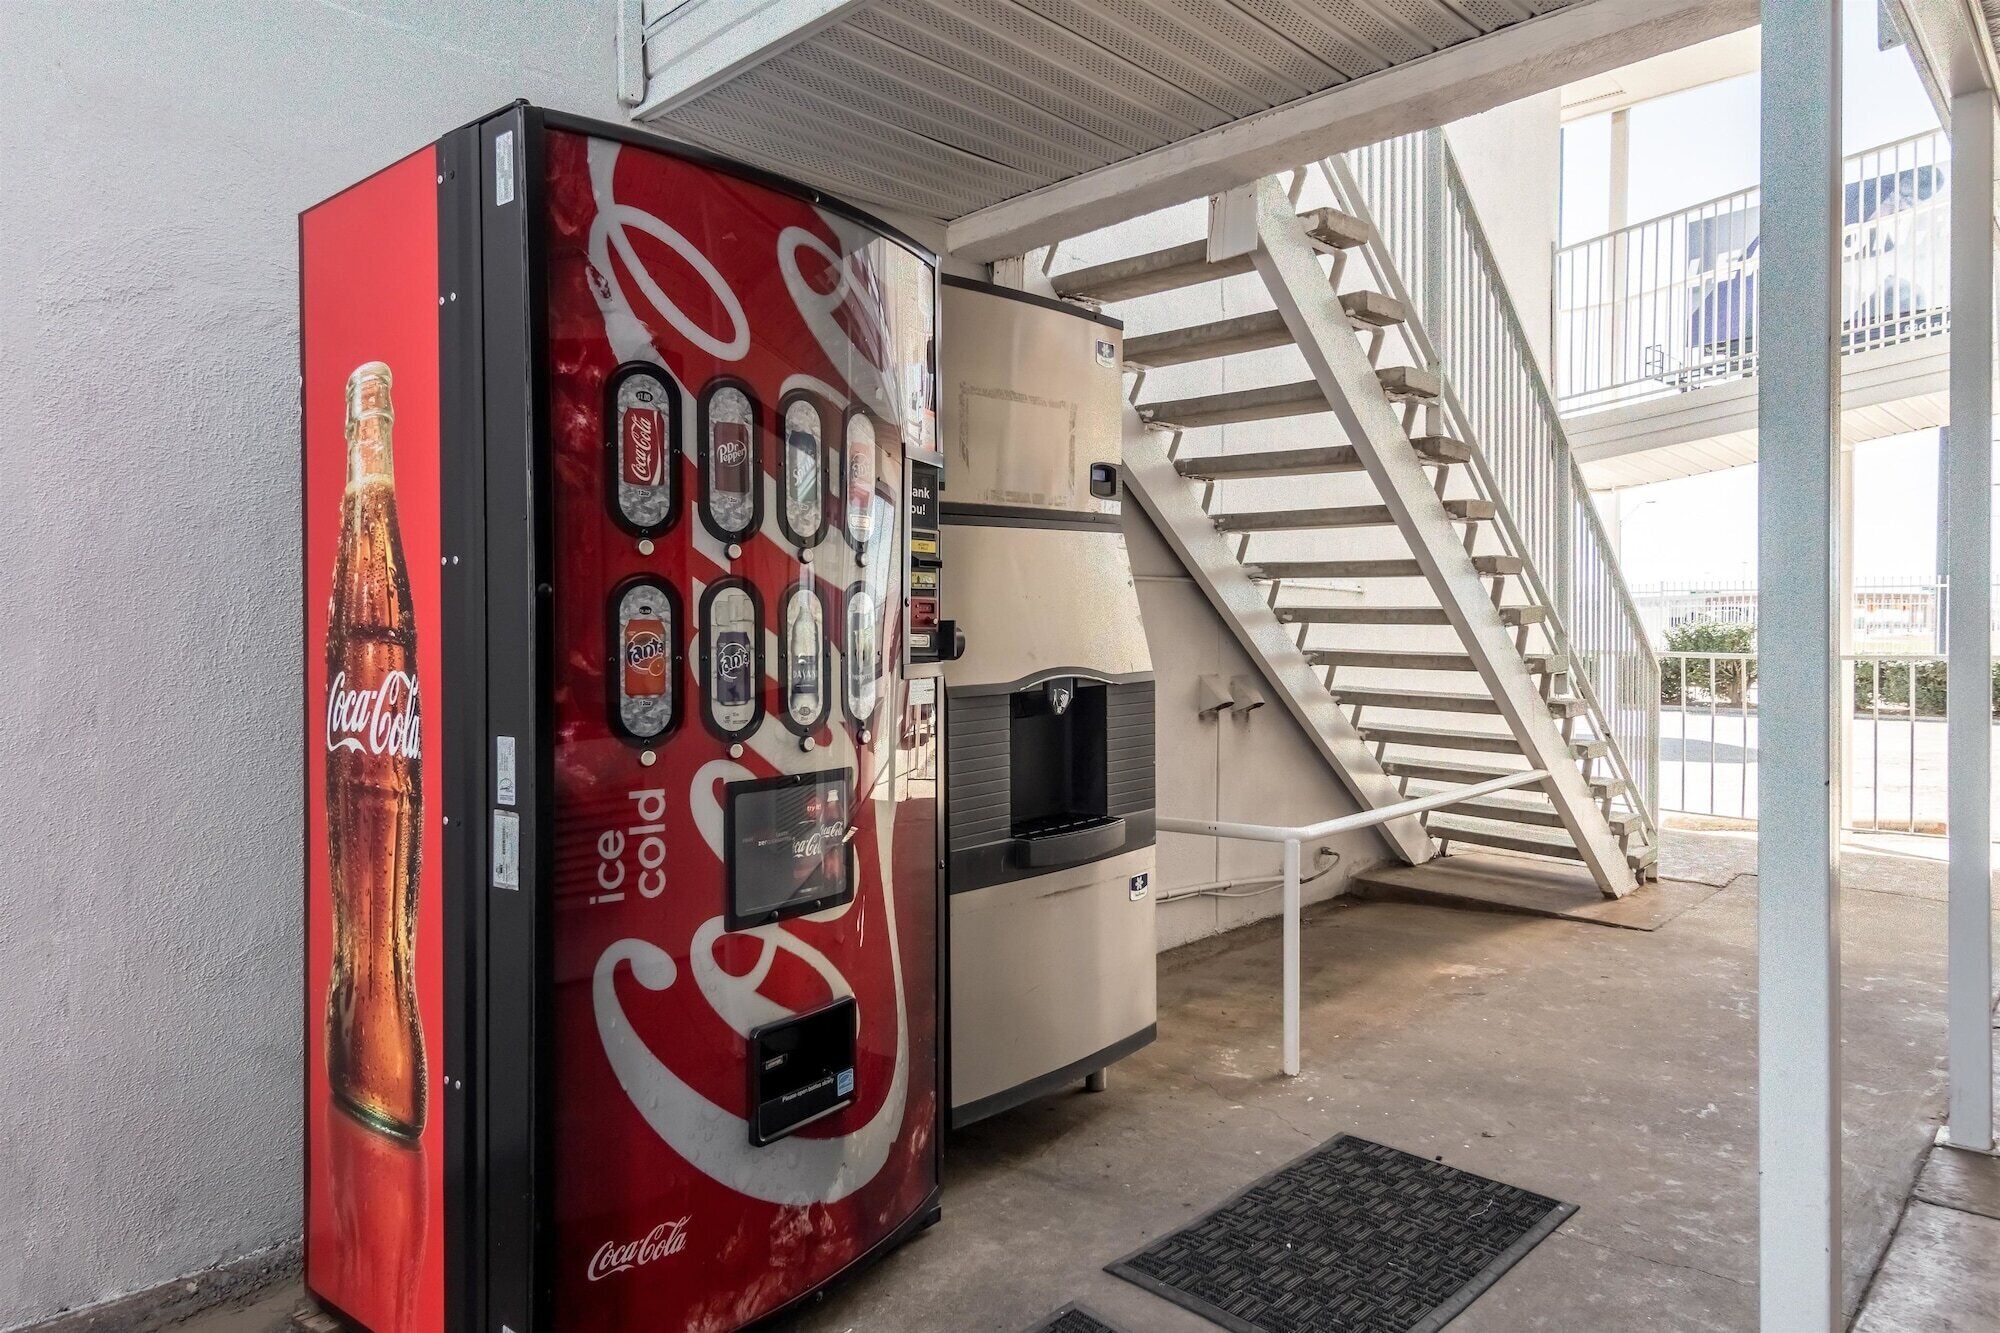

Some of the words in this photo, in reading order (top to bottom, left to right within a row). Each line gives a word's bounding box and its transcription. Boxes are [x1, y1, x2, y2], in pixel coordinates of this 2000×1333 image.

[720, 444, 744, 464] Pepper
[727, 442, 739, 454] Dr
[912, 487, 930, 500] ank
[911, 504, 926, 516] ou!
[627, 638, 665, 668] Fanta
[719, 649, 750, 677] Fanta
[327, 670, 422, 760] Coca-Cola
[628, 788, 667, 899] cold
[589, 829, 626, 905] ice
[588, 1214, 692, 1281] Coca-Cola
